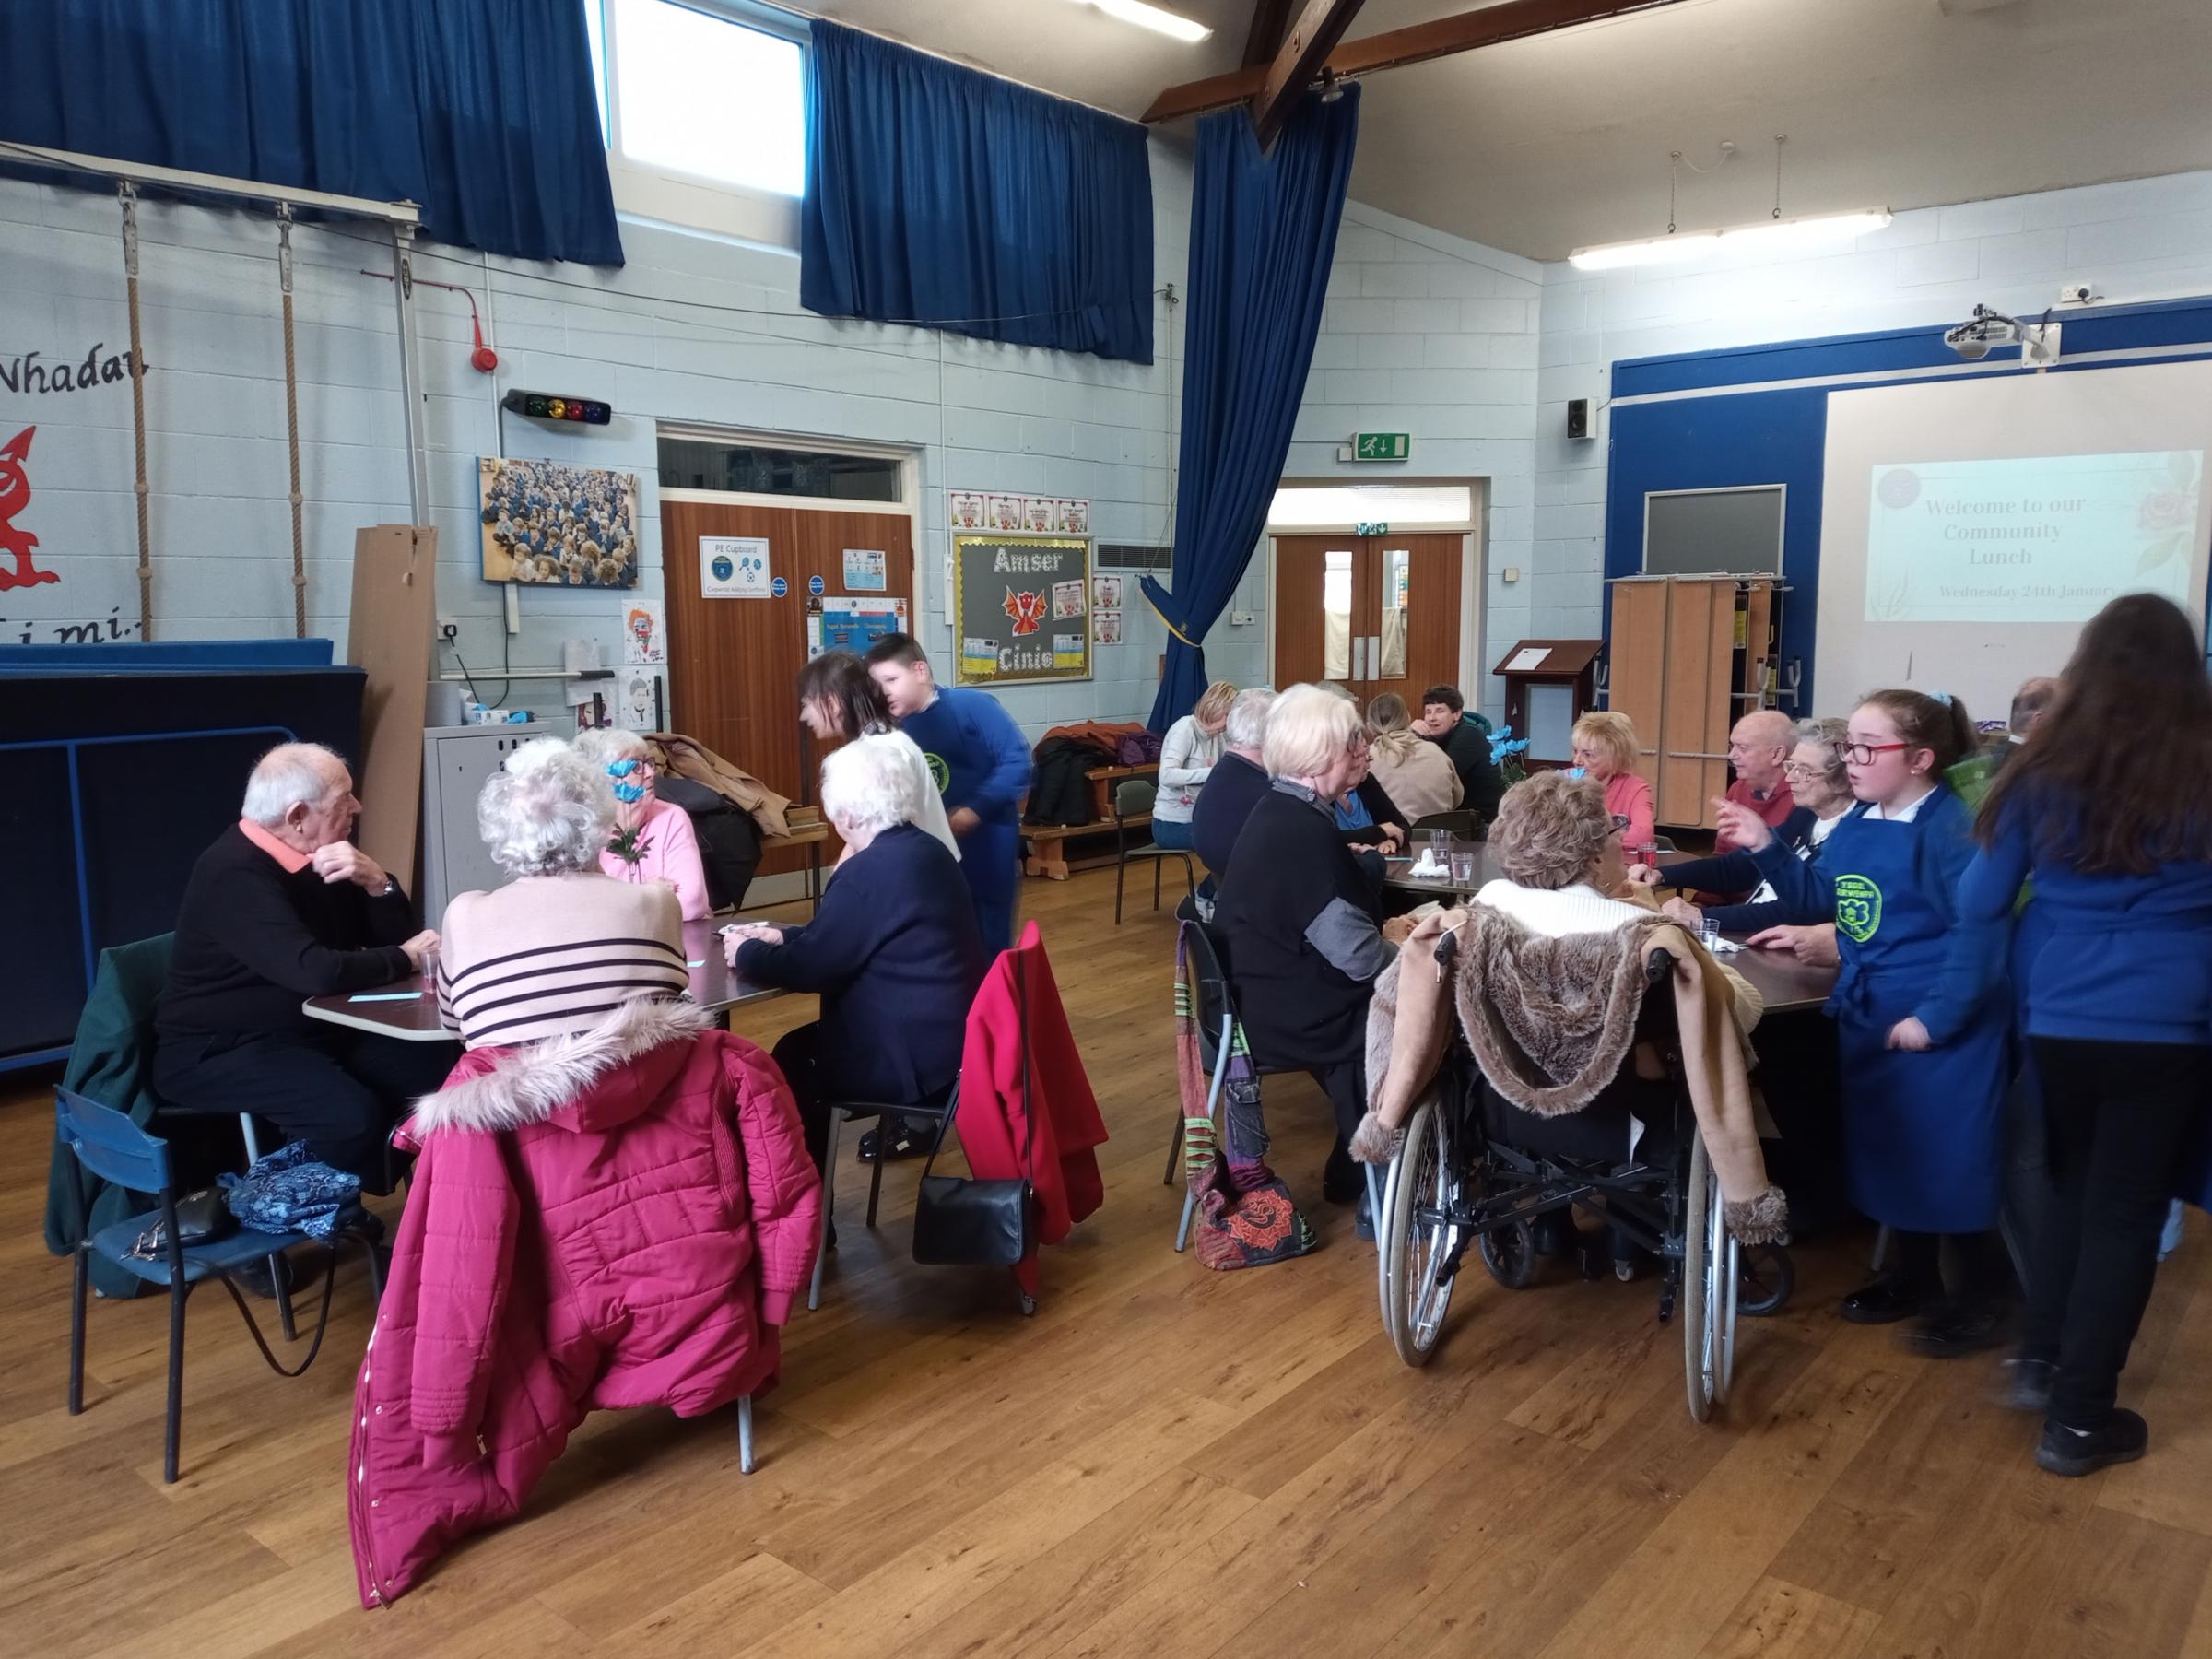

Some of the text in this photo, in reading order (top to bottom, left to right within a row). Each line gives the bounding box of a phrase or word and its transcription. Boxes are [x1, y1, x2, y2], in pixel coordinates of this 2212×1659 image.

[1925, 499, 2087, 515] Welcome to our
[1944, 522, 2061, 543] Community
[715, 544, 758, 554] PE Cupboard
[1969, 548, 2033, 566] Lunch
[994, 546, 1064, 573] Amser
[1939, 585, 2018, 600] Wednesday
[998, 643, 1053, 671] Cinio
